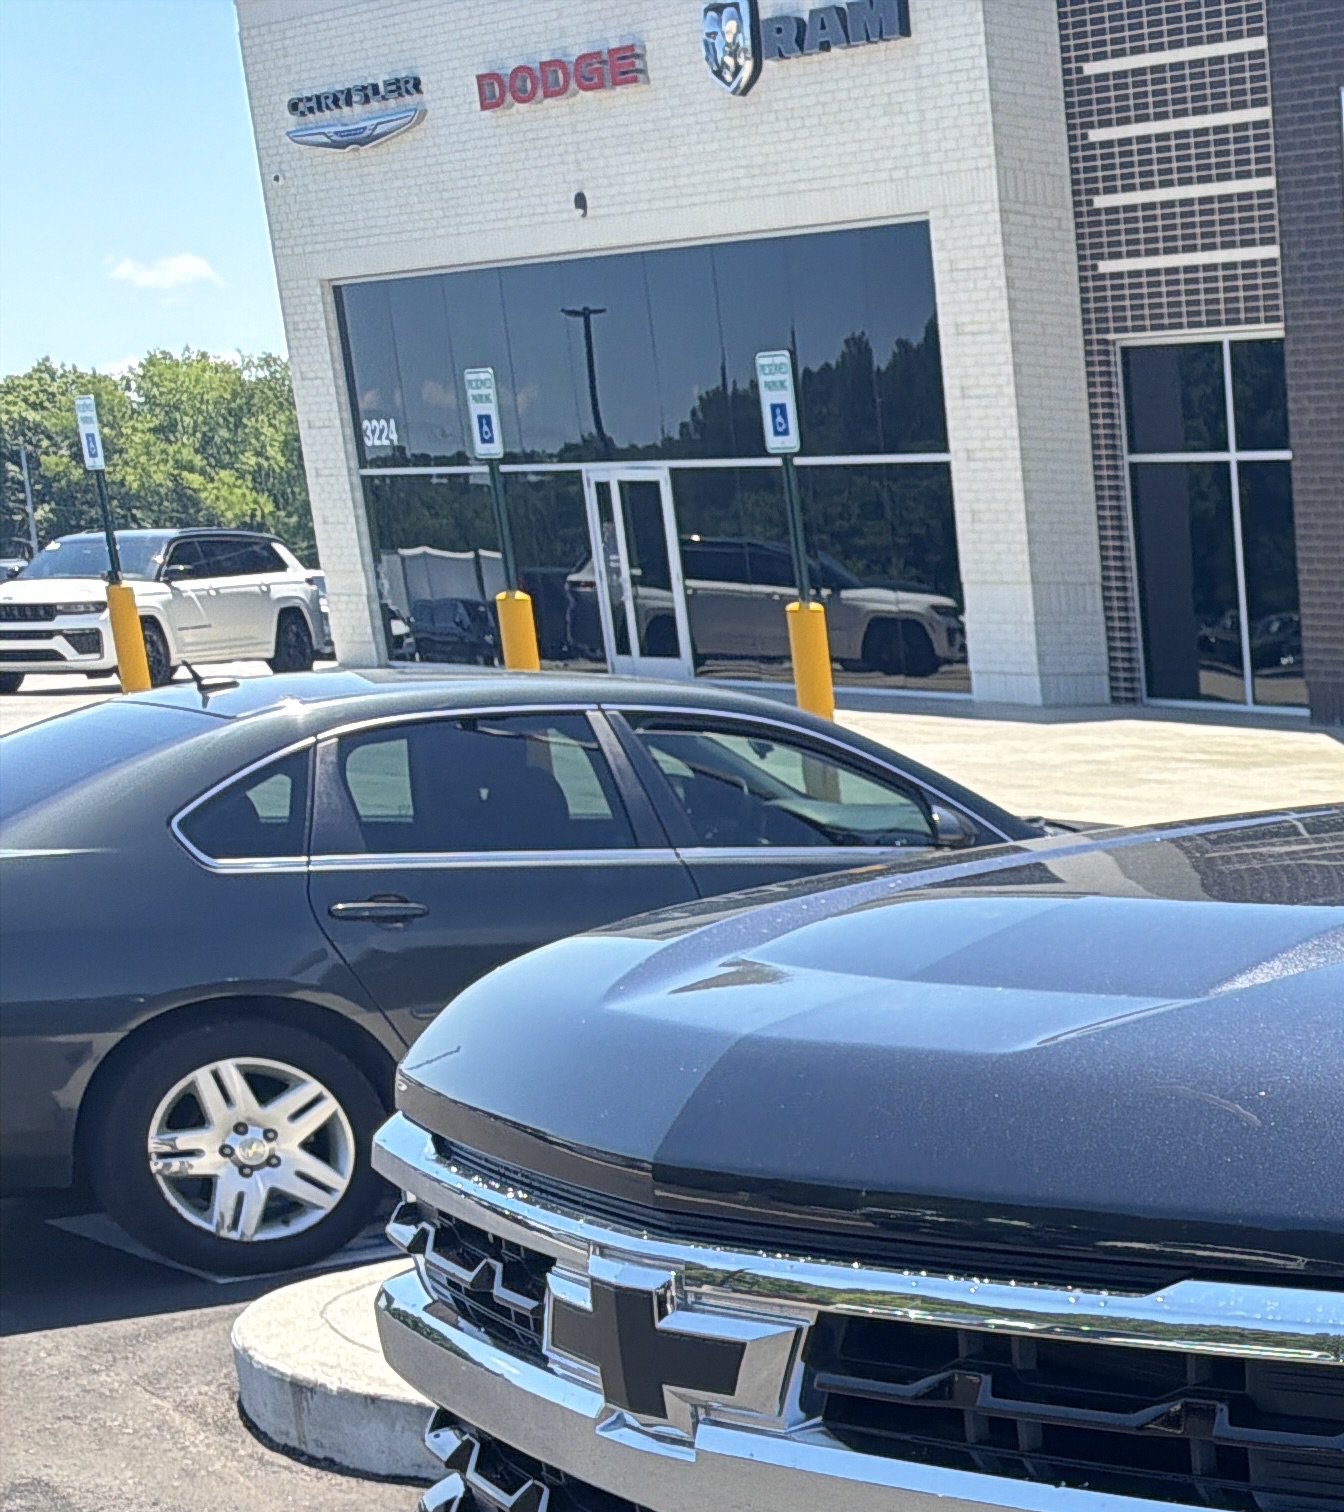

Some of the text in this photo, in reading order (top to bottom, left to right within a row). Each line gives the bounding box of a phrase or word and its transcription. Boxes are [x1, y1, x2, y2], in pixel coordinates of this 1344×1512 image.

[762, 0, 904, 60] RAM
[287, 76, 423, 117] CHRYSLER
[475, 44, 643, 112] DODGE
[362, 418, 398, 446] 3224
